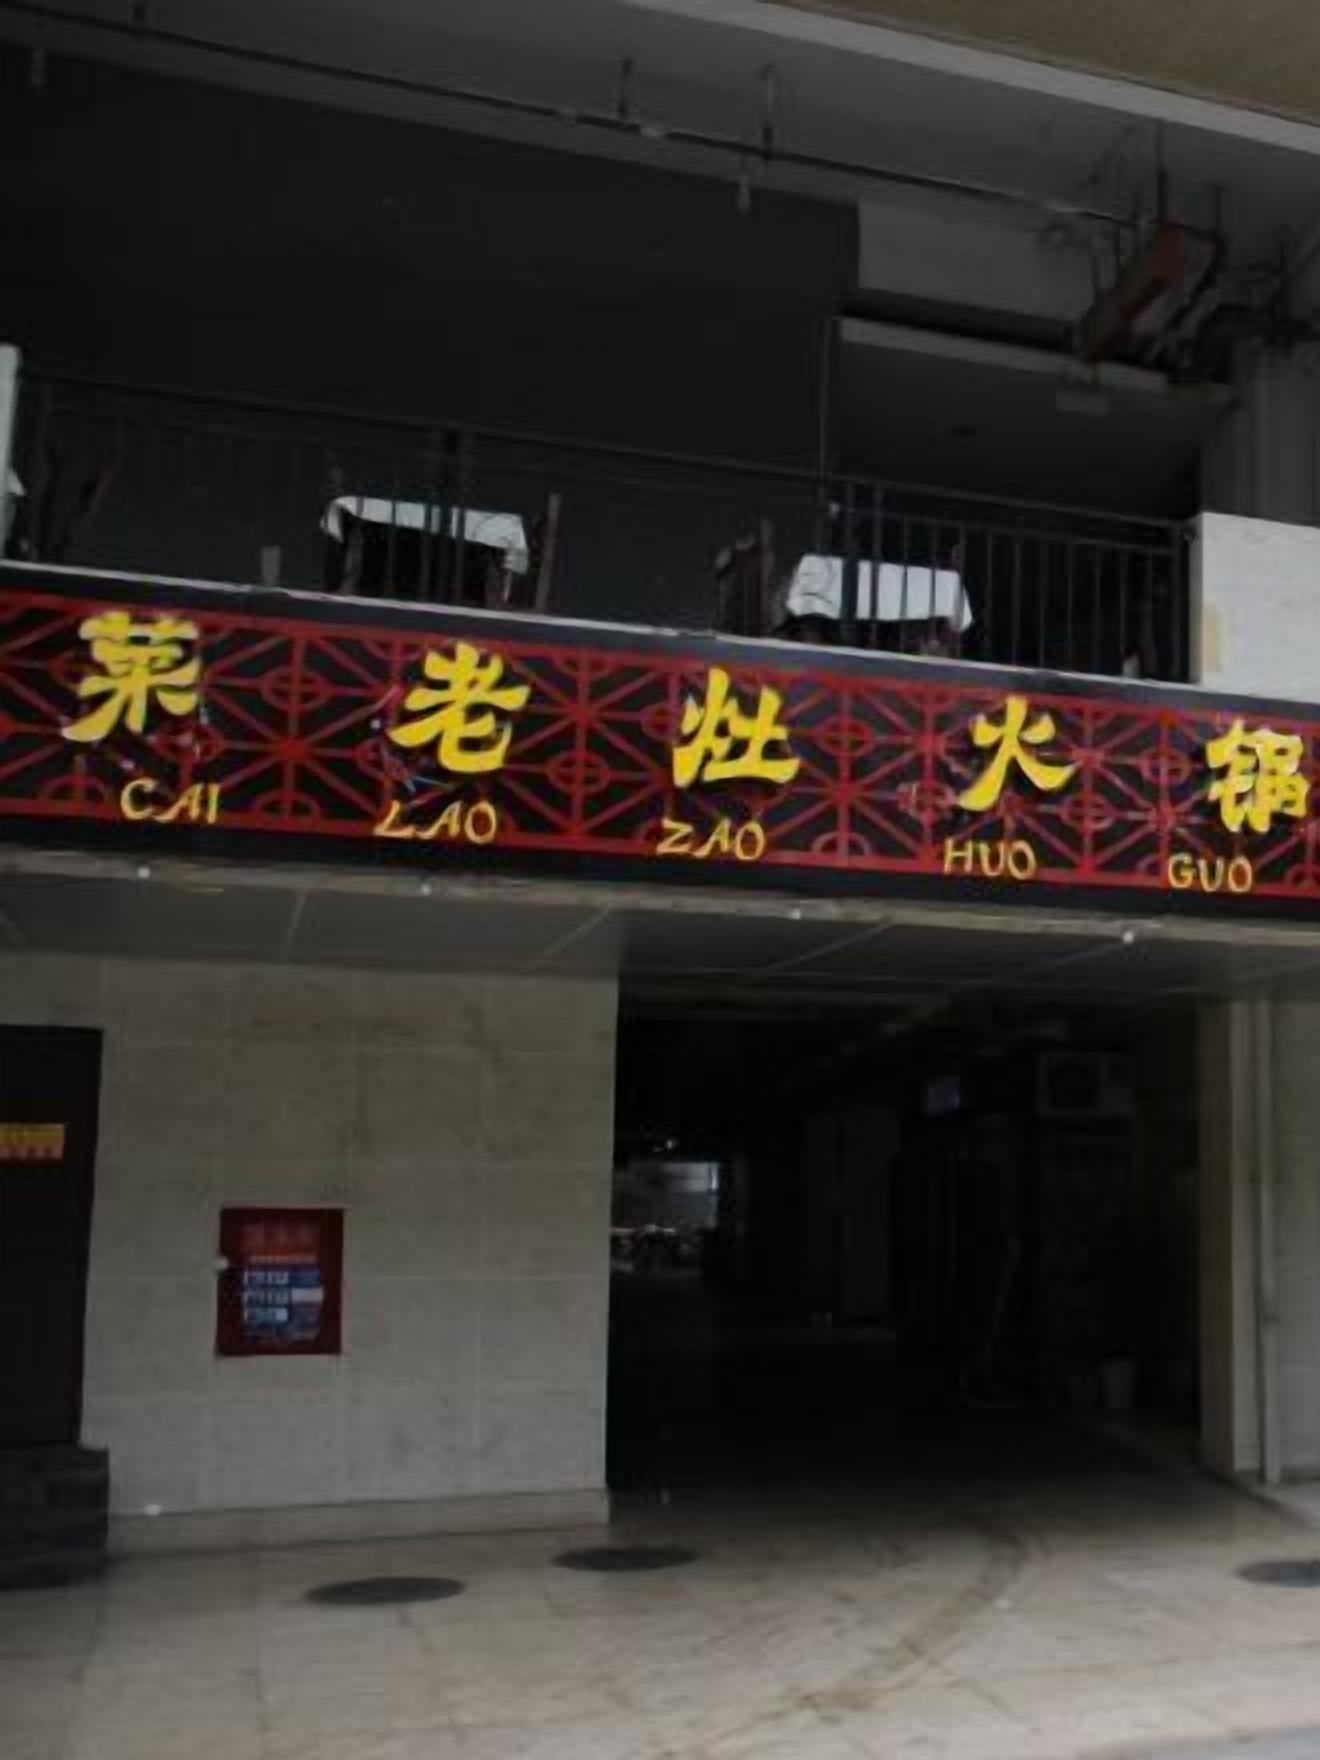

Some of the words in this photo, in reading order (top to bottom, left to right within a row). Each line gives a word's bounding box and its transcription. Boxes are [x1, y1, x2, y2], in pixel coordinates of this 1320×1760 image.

[119, 780, 220, 824] CAI
[373, 801, 499, 846] LAO
[655, 820, 767, 862] ZAO
[942, 838, 1038, 881] HUO
[1166, 854, 1254, 894] GUO
